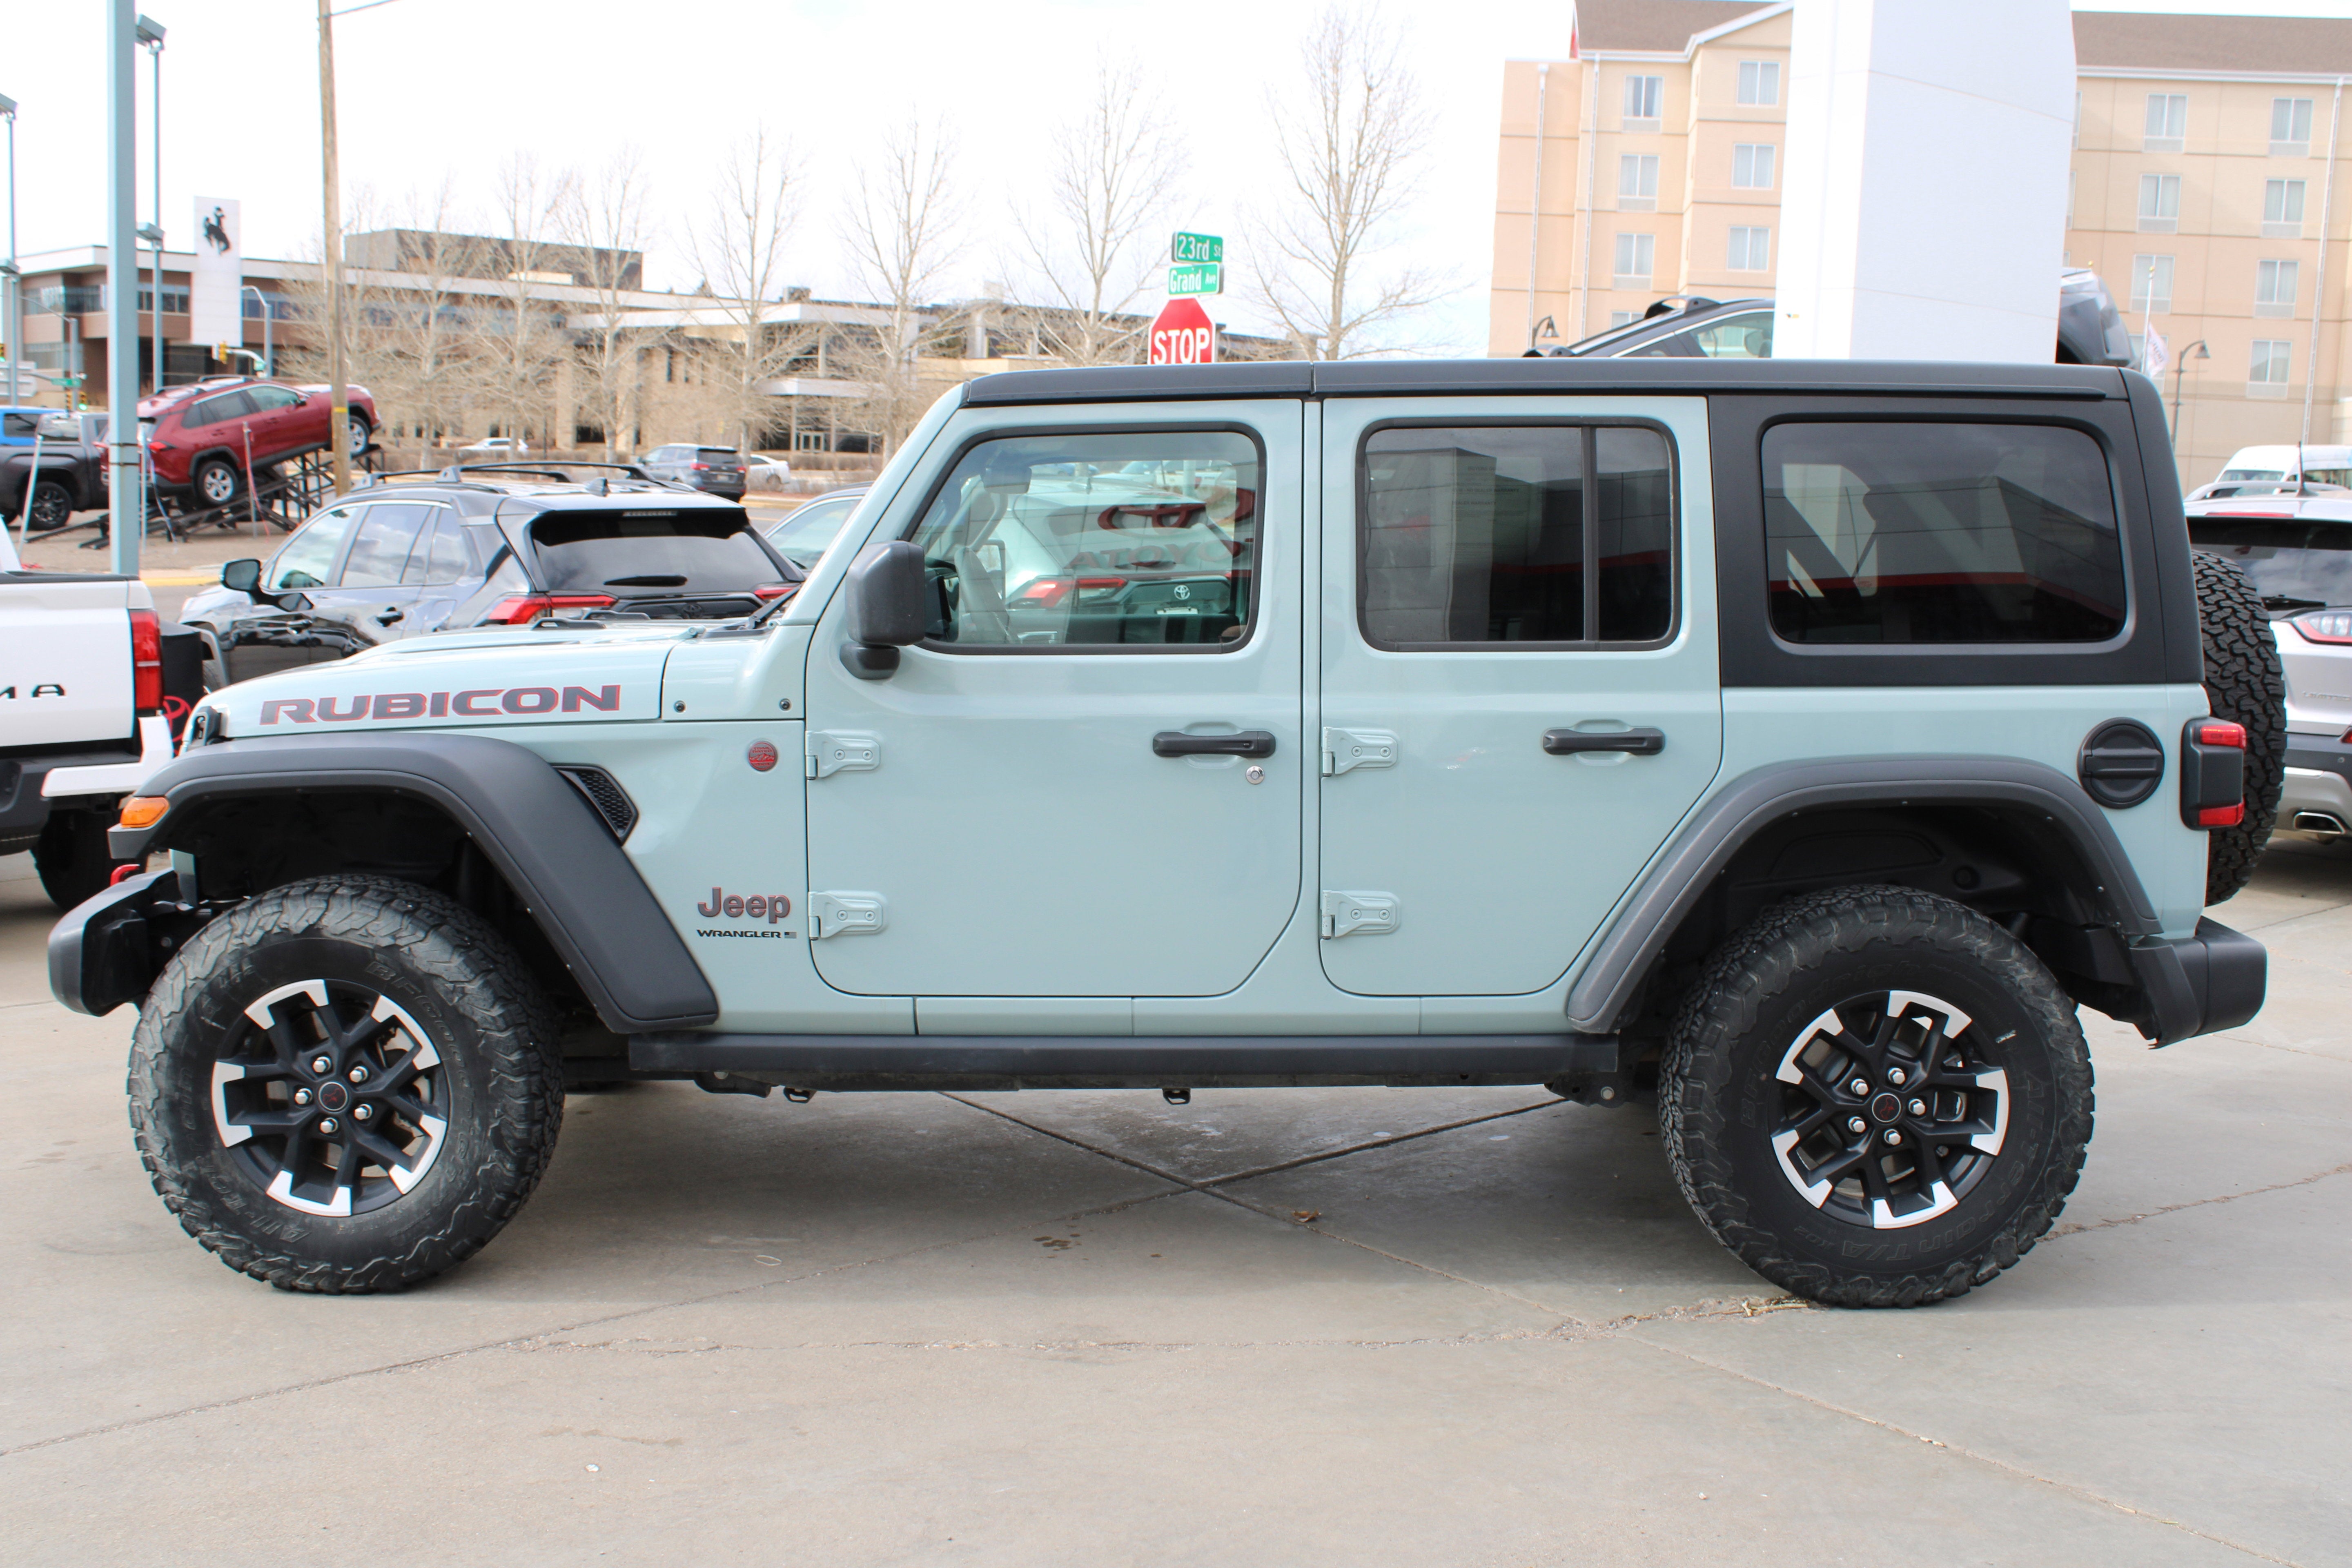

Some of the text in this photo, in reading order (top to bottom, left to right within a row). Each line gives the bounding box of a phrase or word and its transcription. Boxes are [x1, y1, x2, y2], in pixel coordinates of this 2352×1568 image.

[1178, 235, 1210, 261] 23rd
[1169, 268, 1216, 293] Grand Ave
[1153, 327, 1210, 365] STOP
[260, 685, 621, 726] RUBICON
[697, 886, 791, 924] Jeep
[697, 929, 782, 939] WRANGLER
